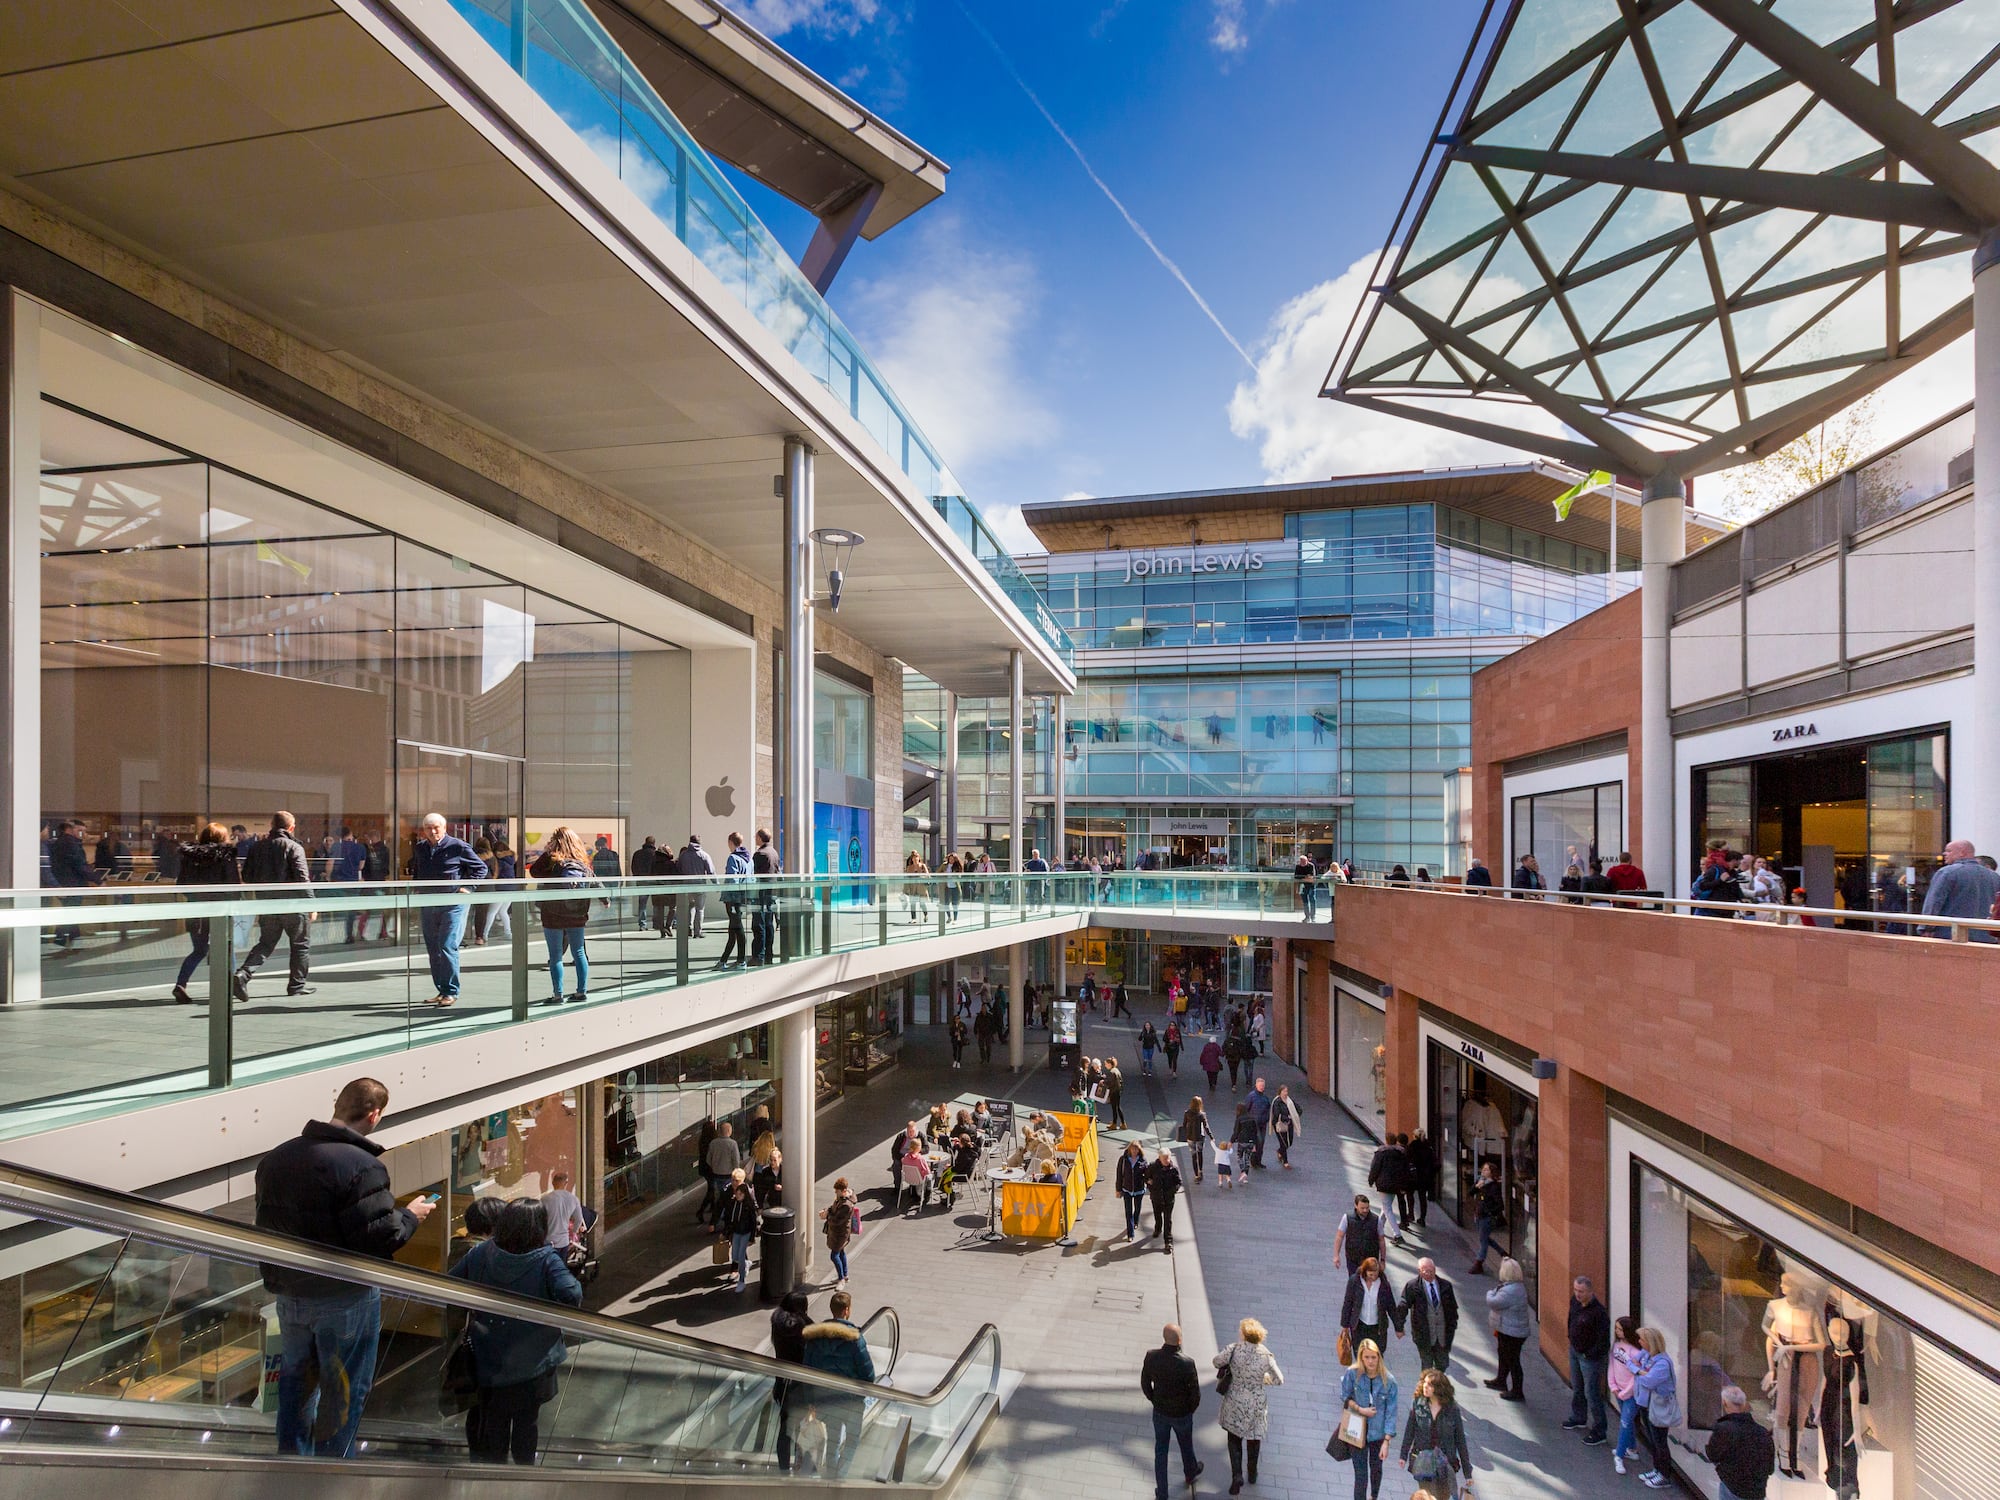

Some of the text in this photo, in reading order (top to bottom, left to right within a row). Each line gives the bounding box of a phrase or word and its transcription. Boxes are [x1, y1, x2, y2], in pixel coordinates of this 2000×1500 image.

[1124, 546, 1263, 583] John Lewis
[1772, 723, 1818, 741] ZARA
[1170, 822, 1208, 831] John Lewis
[1461, 1041, 1484, 1063] ZARA
